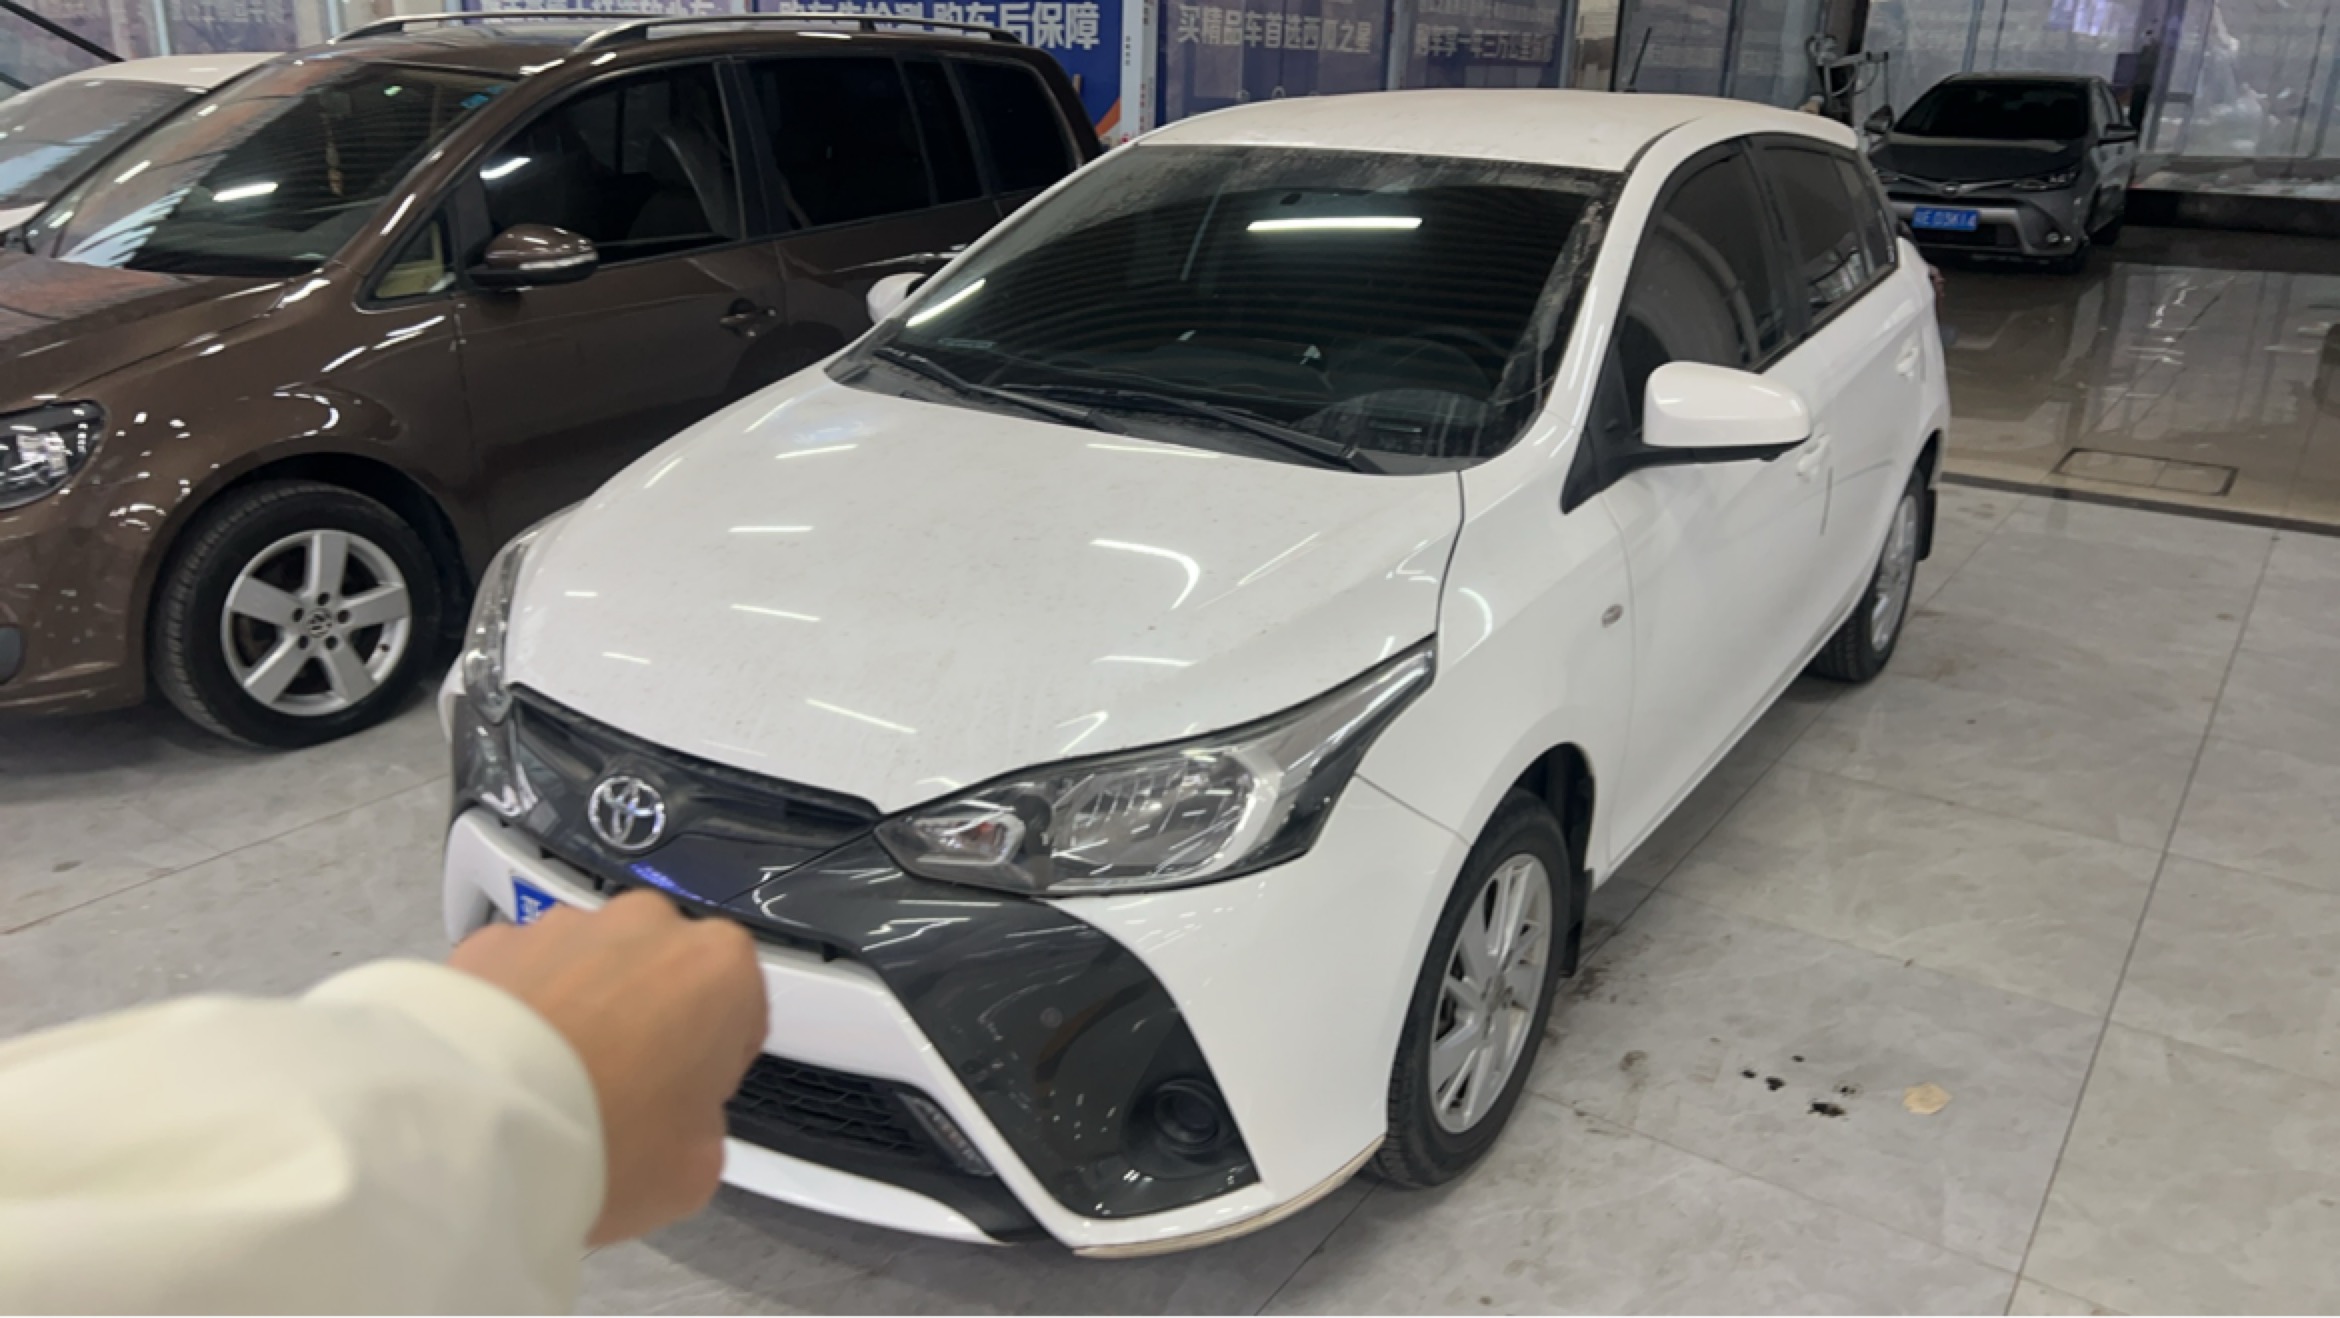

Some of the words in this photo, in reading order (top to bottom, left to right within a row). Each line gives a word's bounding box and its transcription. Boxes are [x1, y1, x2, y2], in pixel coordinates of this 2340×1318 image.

[933, 1, 1101, 50] 购车后保障
